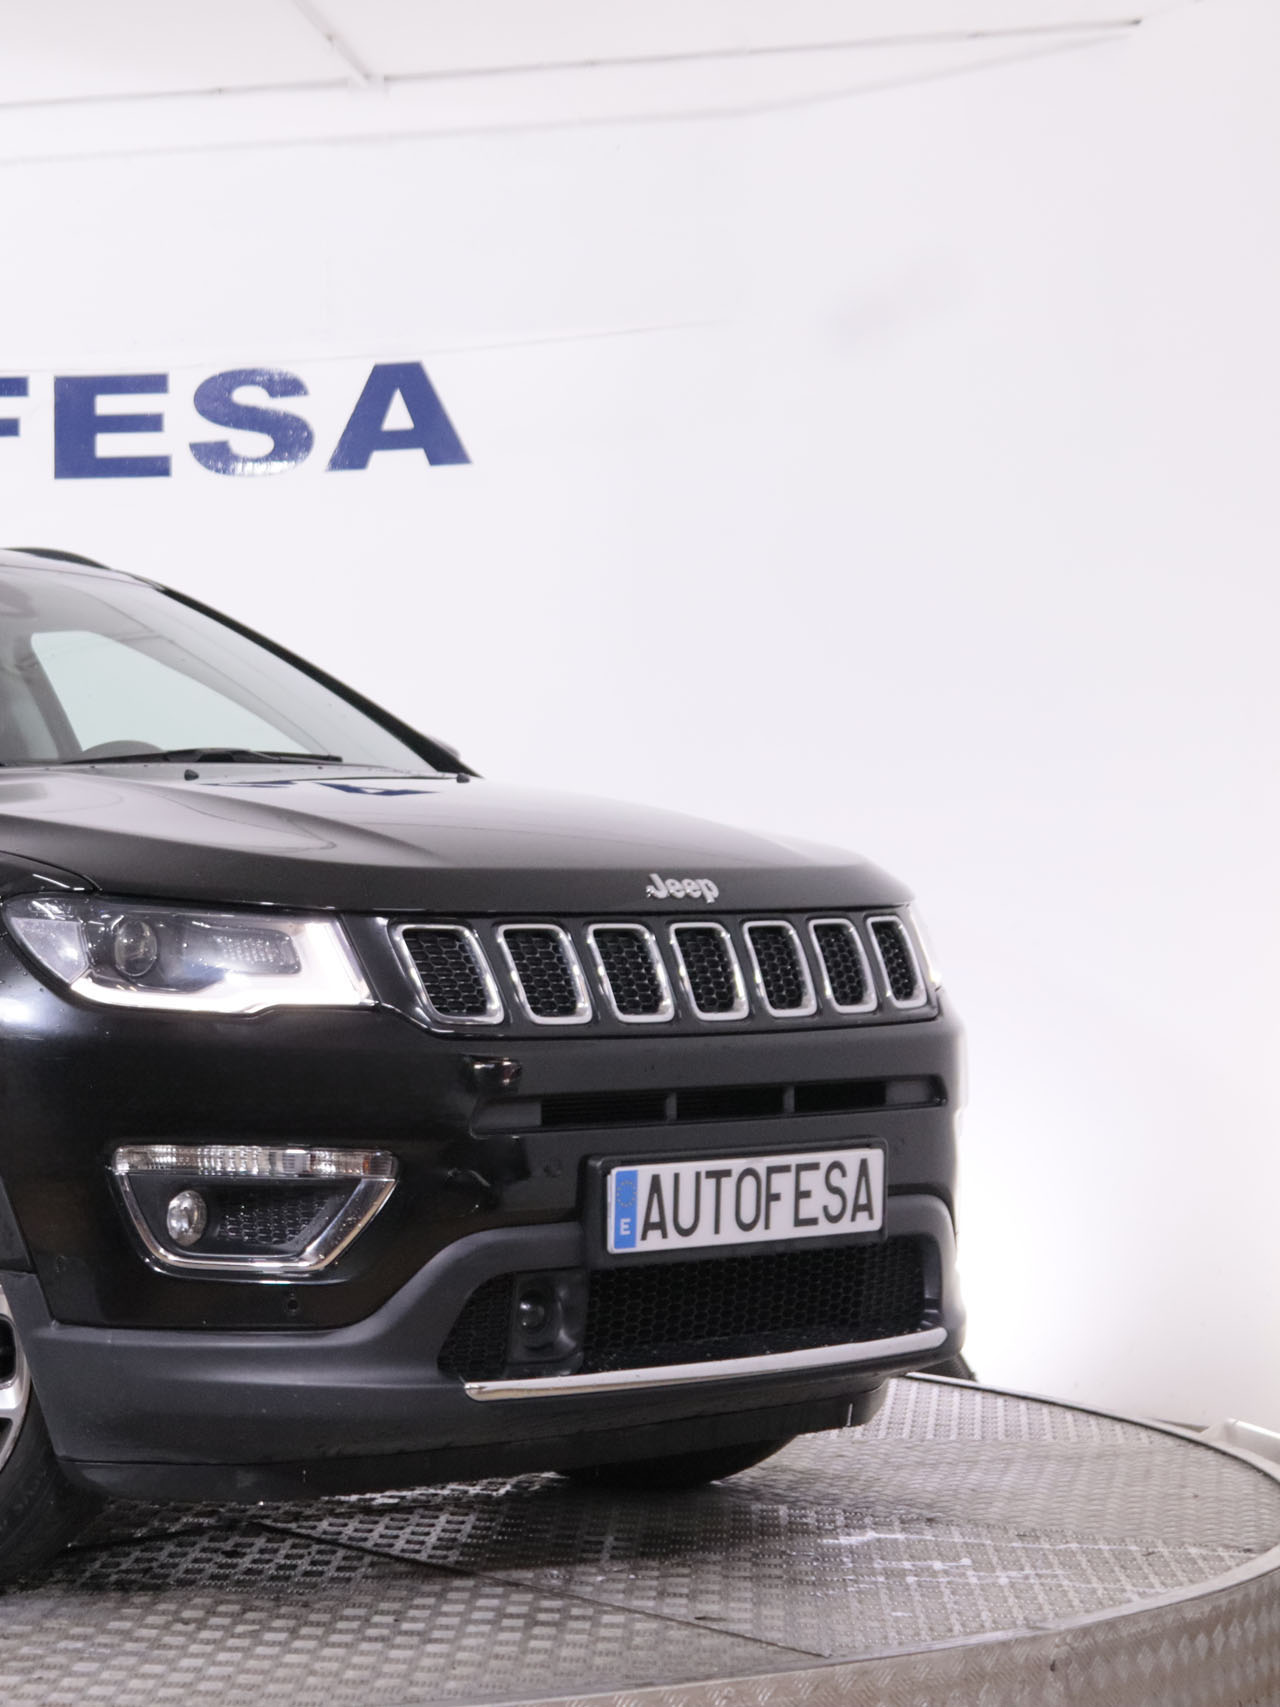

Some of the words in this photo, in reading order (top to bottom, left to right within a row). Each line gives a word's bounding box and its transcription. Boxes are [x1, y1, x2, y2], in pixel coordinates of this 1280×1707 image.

[645, 873, 719, 904] Jeep
[640, 1158, 875, 1241] AUTOFESA
[620, 1217, 631, 1235] E
